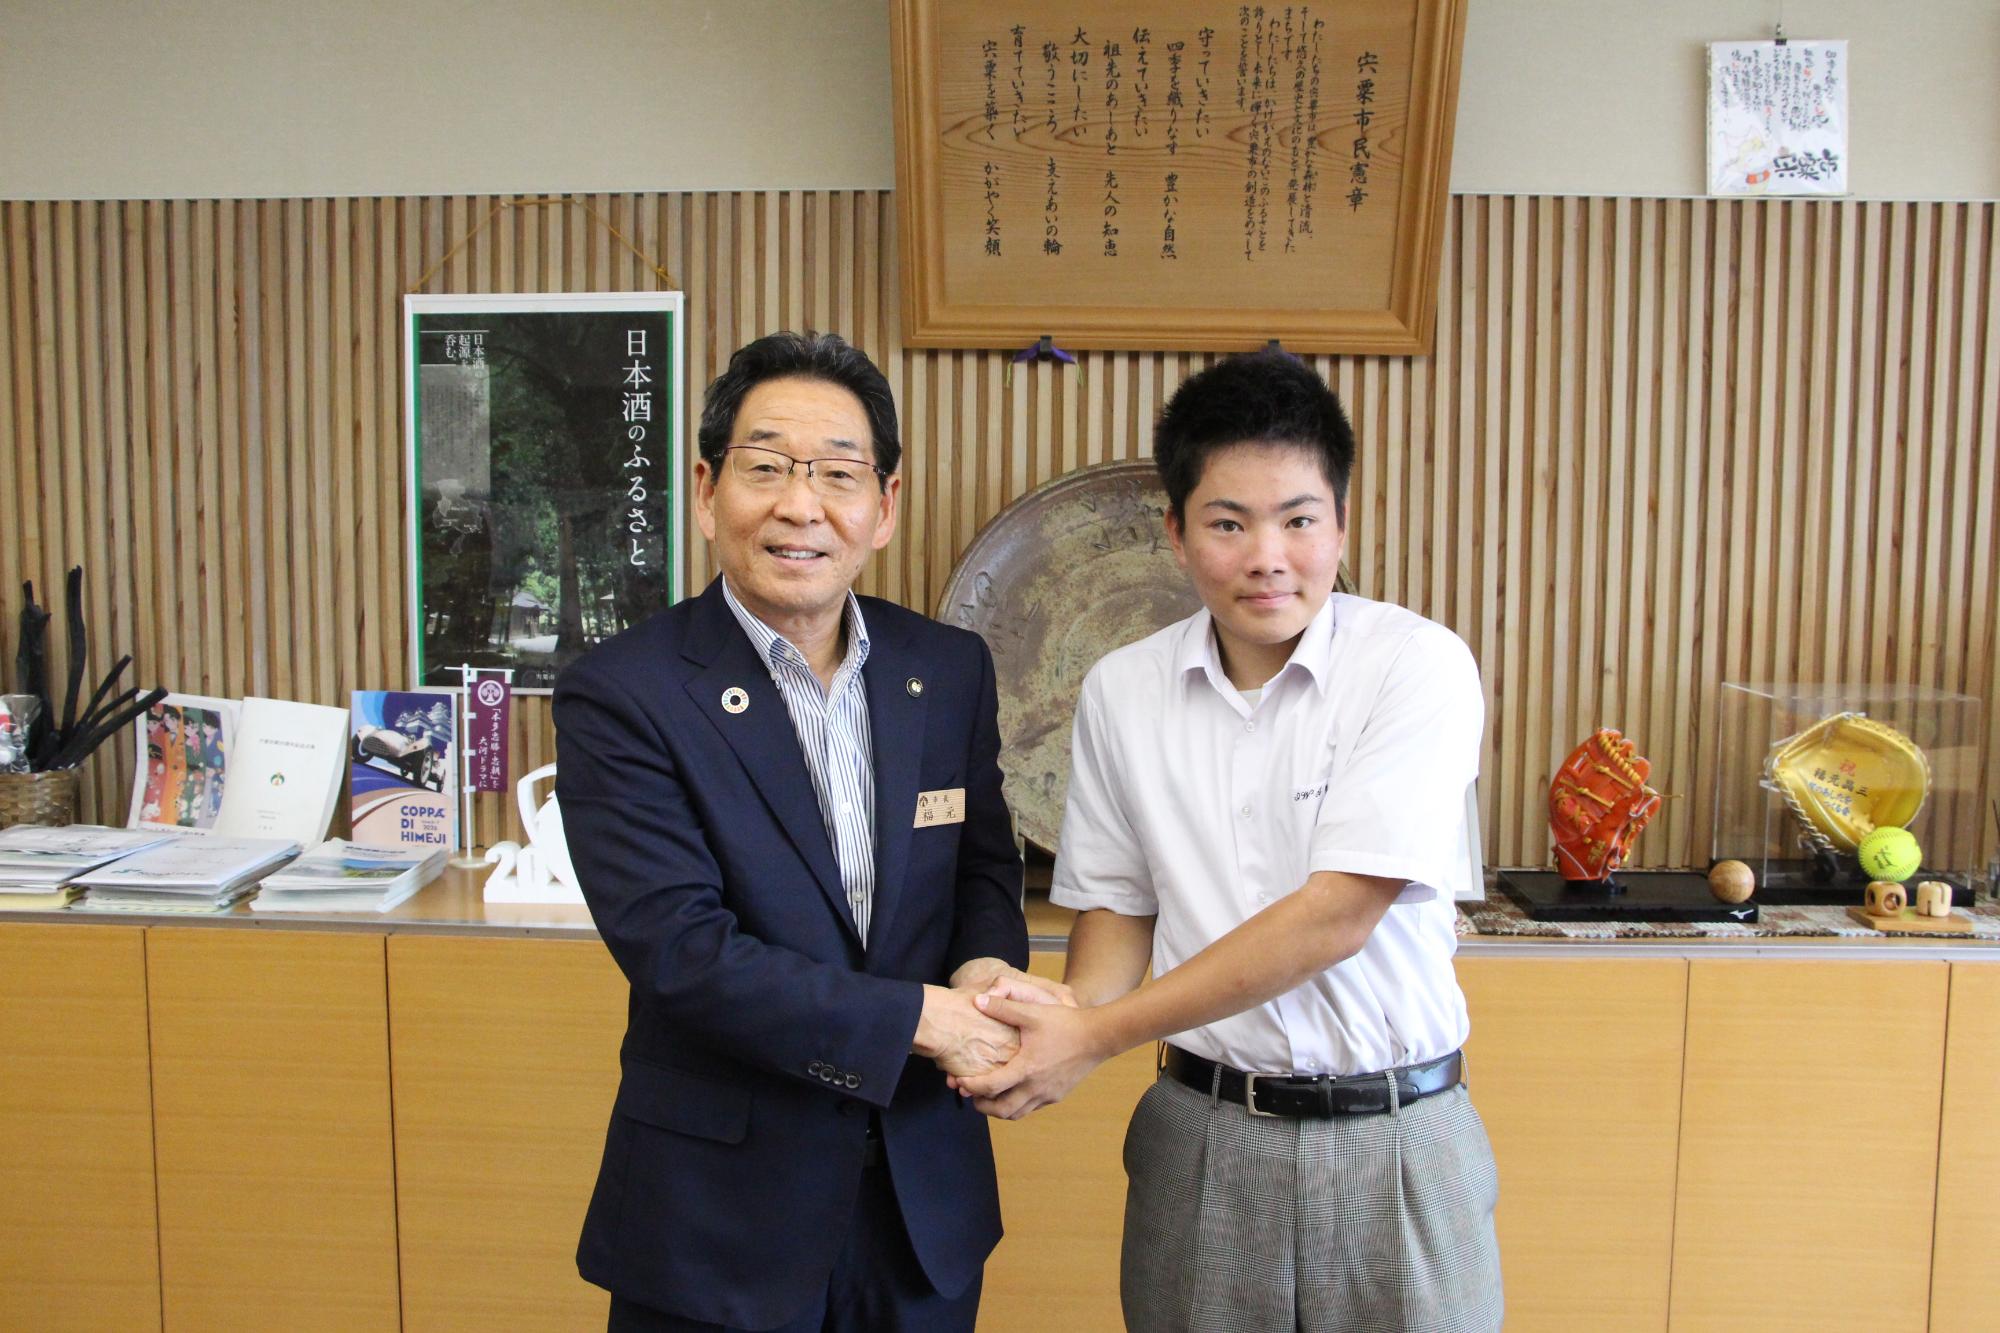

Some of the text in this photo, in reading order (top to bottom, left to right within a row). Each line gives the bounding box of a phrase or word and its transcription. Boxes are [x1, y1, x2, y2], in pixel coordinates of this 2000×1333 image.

[1010, 23, 1027, 139] 育てていきたい
[1070, 26, 1091, 138] 大切にしたい
[1133, 26, 1150, 138] 伝えていきたい
[1196, 27, 1215, 139] 守っていきたい
[1345, 52, 1379, 213] 宍粟市民憲章
[982, 39, 1002, 257] 宍粟を築く かがやく笑顔
[1042, 40, 1064, 256] 敬うこころ 支えあいの輪
[1102, 39, 1122, 257] 祖先のあしあと 先人の知恵
[1160, 41, 1185, 260] 四季を織りなす 豊かな自然
[622, 329, 652, 566] 日本酒のふるさと
[401, 805, 446, 818] COPPA
[478, 736, 488, 788] 大河ドラマに
[401, 818, 414, 829] DI
[401, 831, 446, 844] HIMEJI
